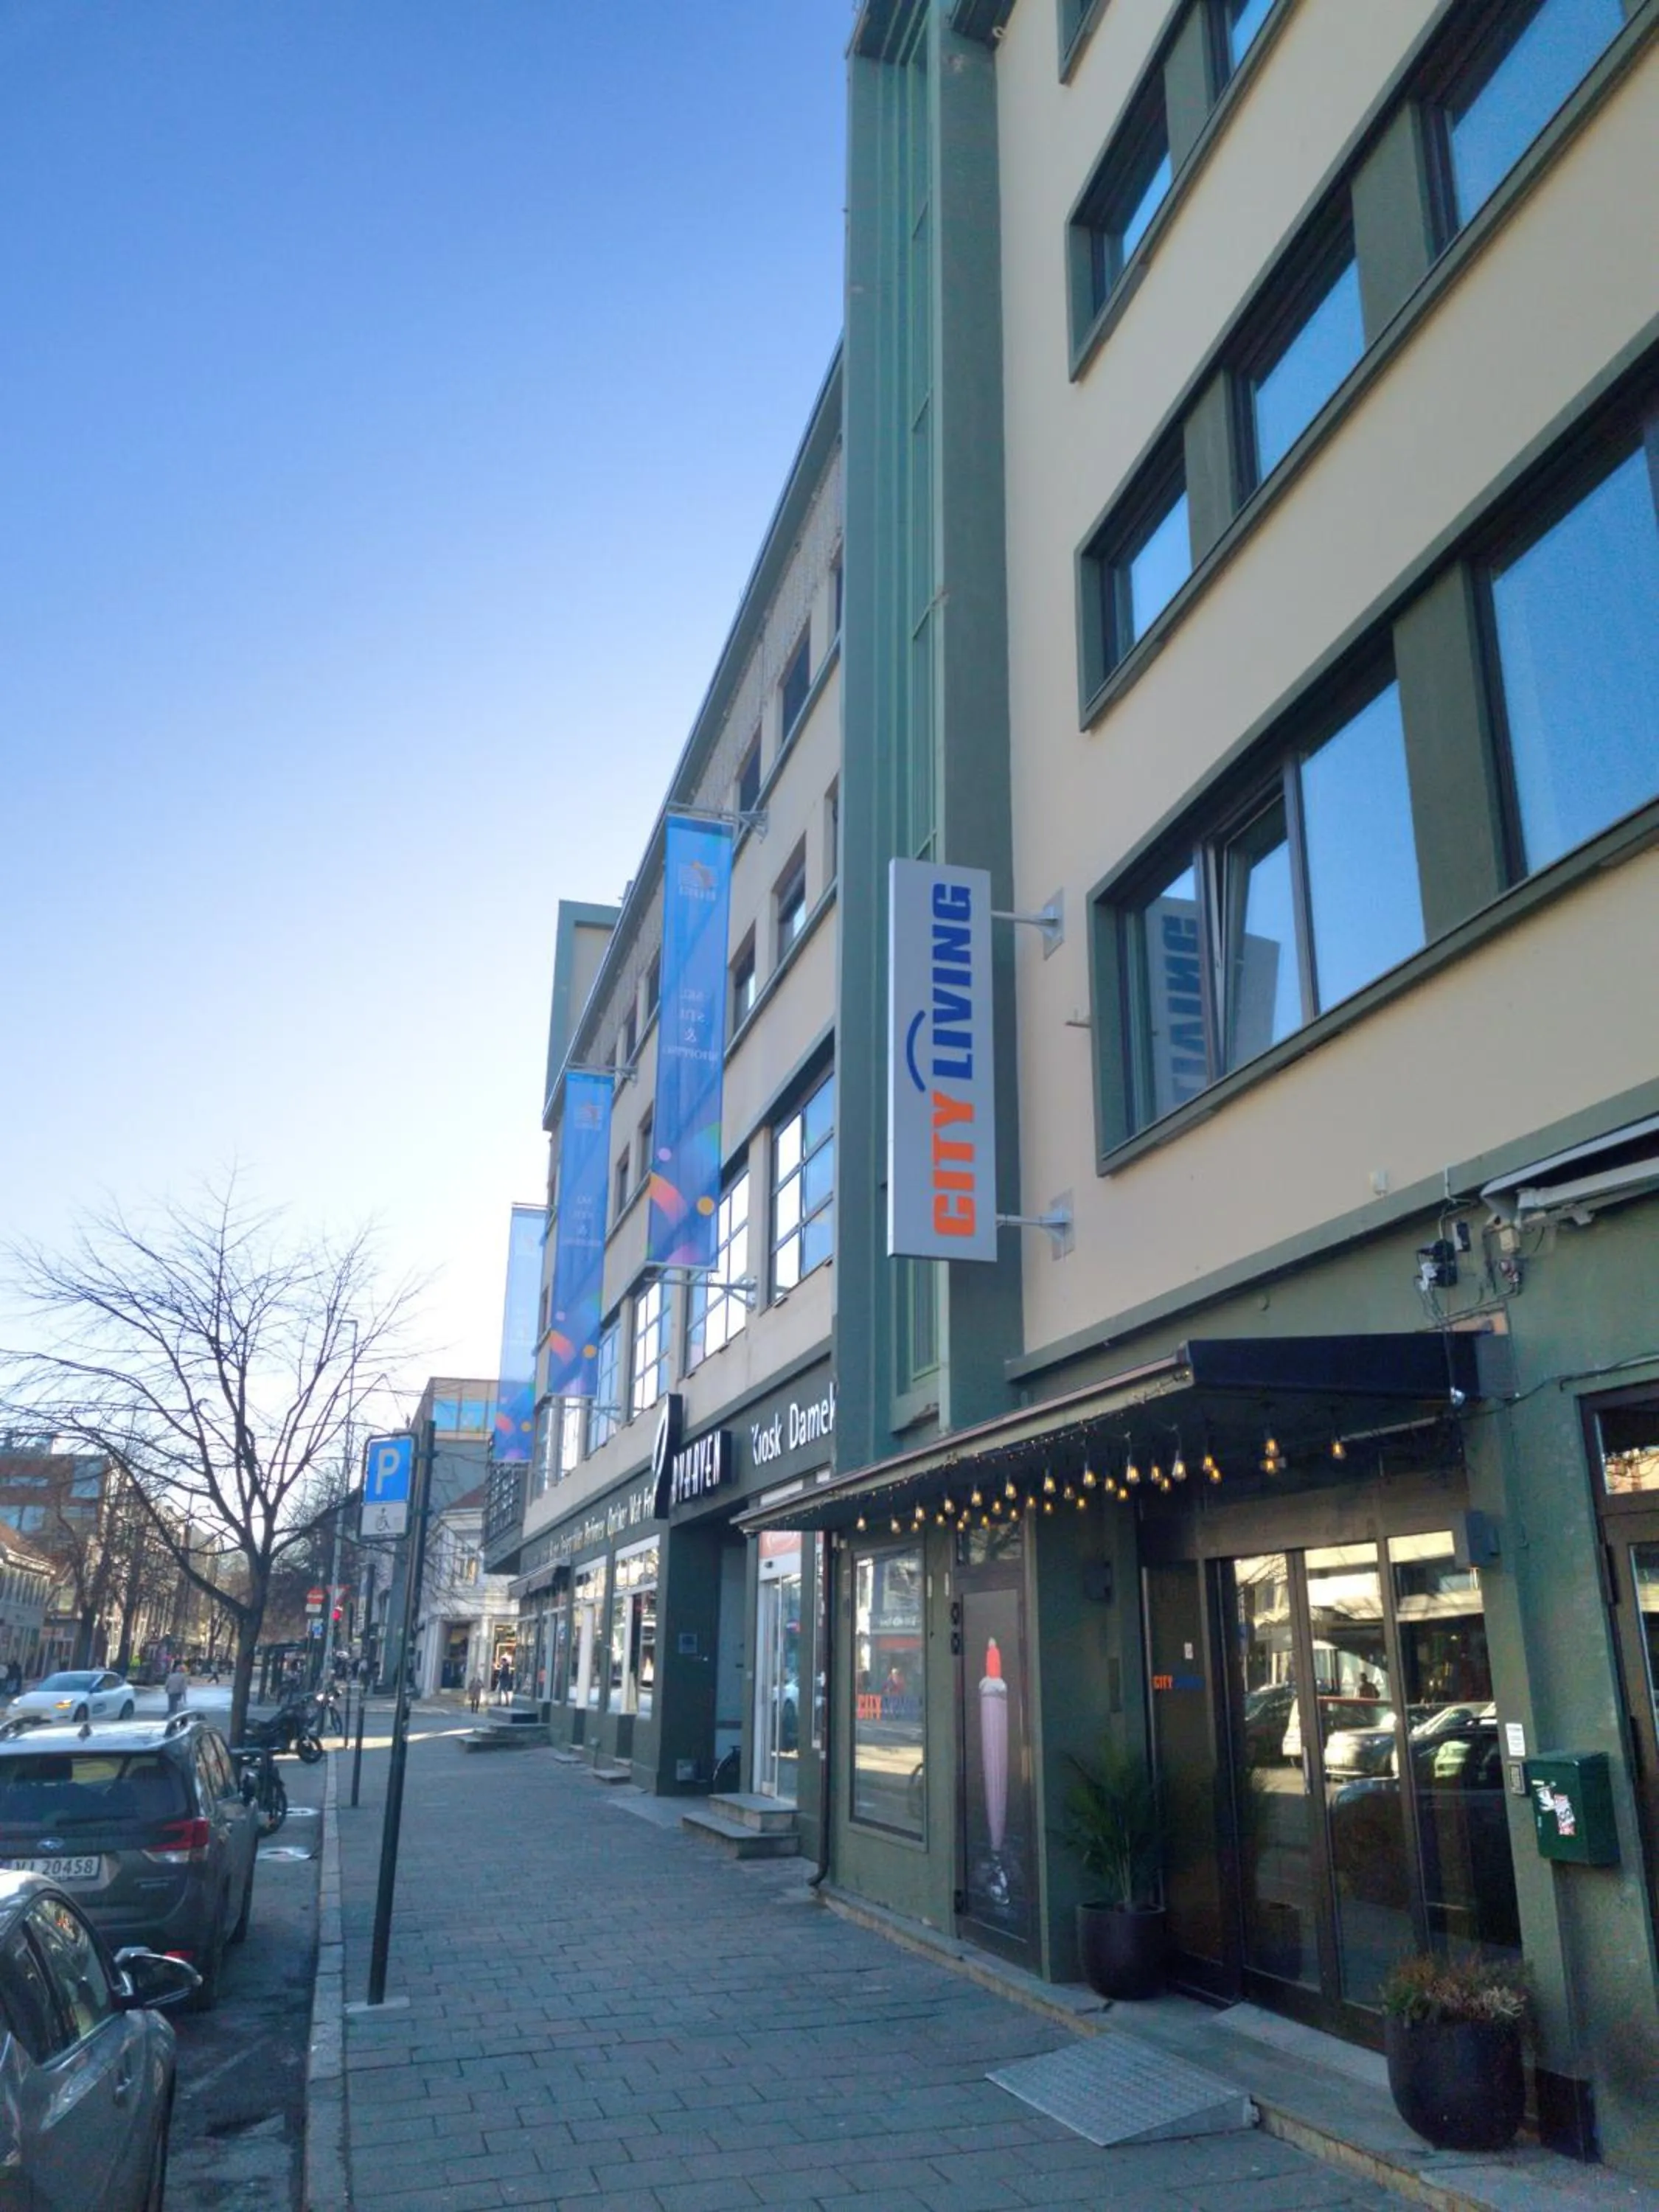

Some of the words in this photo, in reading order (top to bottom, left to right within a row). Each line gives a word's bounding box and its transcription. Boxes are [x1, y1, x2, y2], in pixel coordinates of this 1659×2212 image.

[931, 883, 973, 1081] LIVING
[932, 1090, 976, 1237] CITY
[751, 1413, 782, 1466] Kiosk
[375, 1447, 400, 1495] P
[671, 1430, 721, 1506] BYHAVEN
[858, 1694, 881, 1723] CITY
[43, 1860, 93, 1874] 20458
